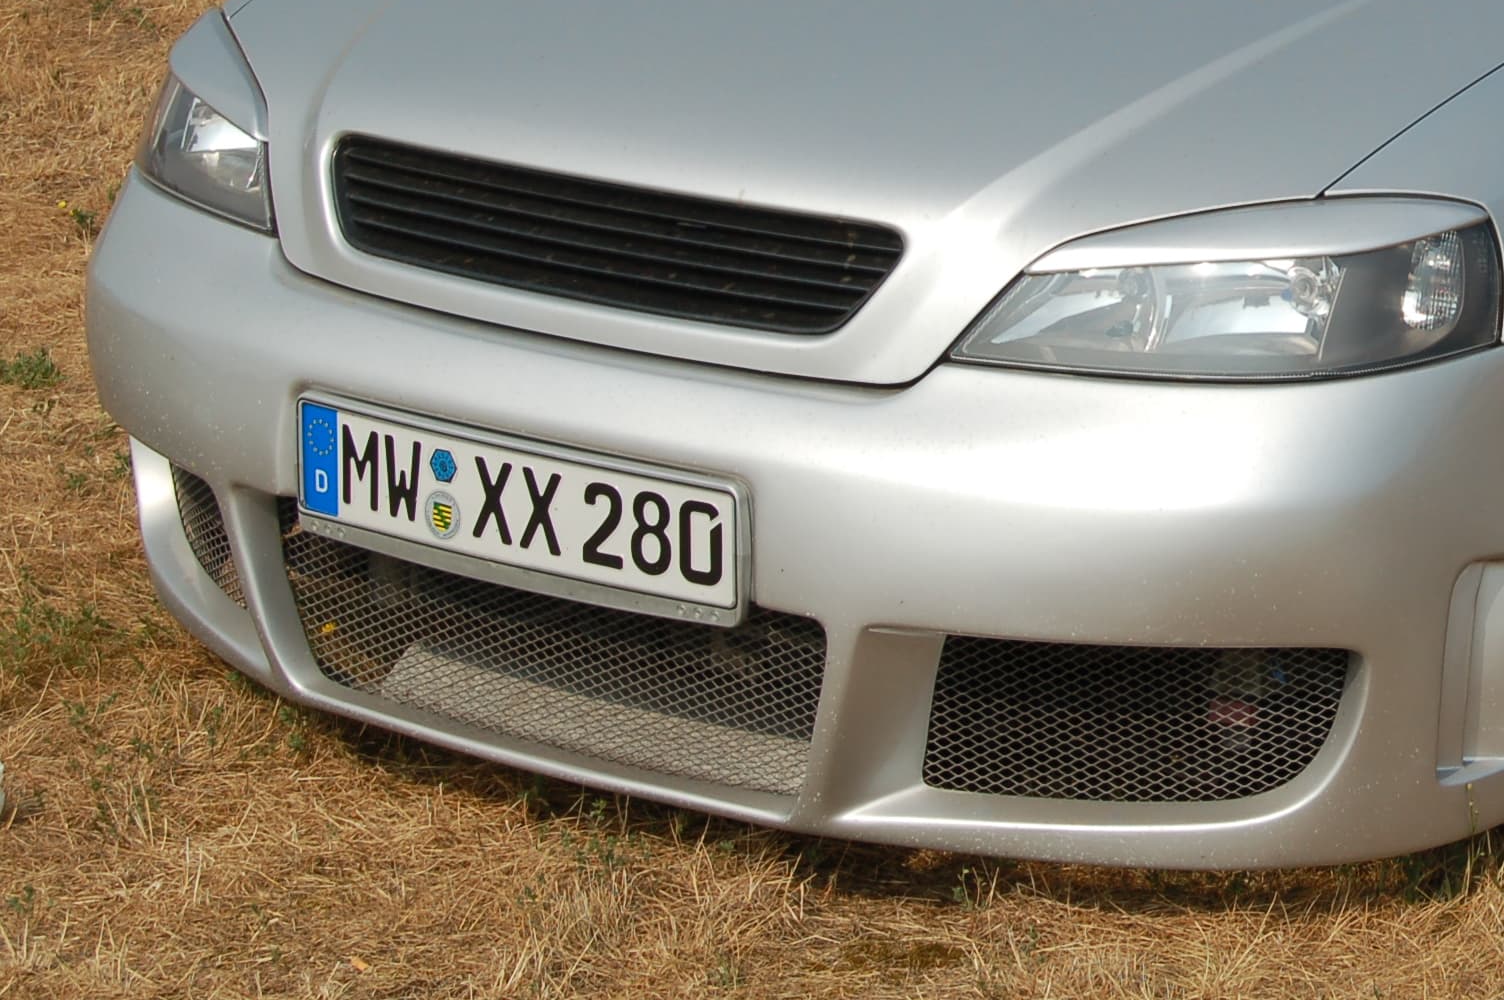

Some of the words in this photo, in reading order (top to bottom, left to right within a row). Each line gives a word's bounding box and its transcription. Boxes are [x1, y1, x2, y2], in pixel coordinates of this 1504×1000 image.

[315, 468, 329, 494] D
[341, 423, 422, 522] MW
[473, 455, 562, 557] XX
[582, 481, 723, 587] 280
